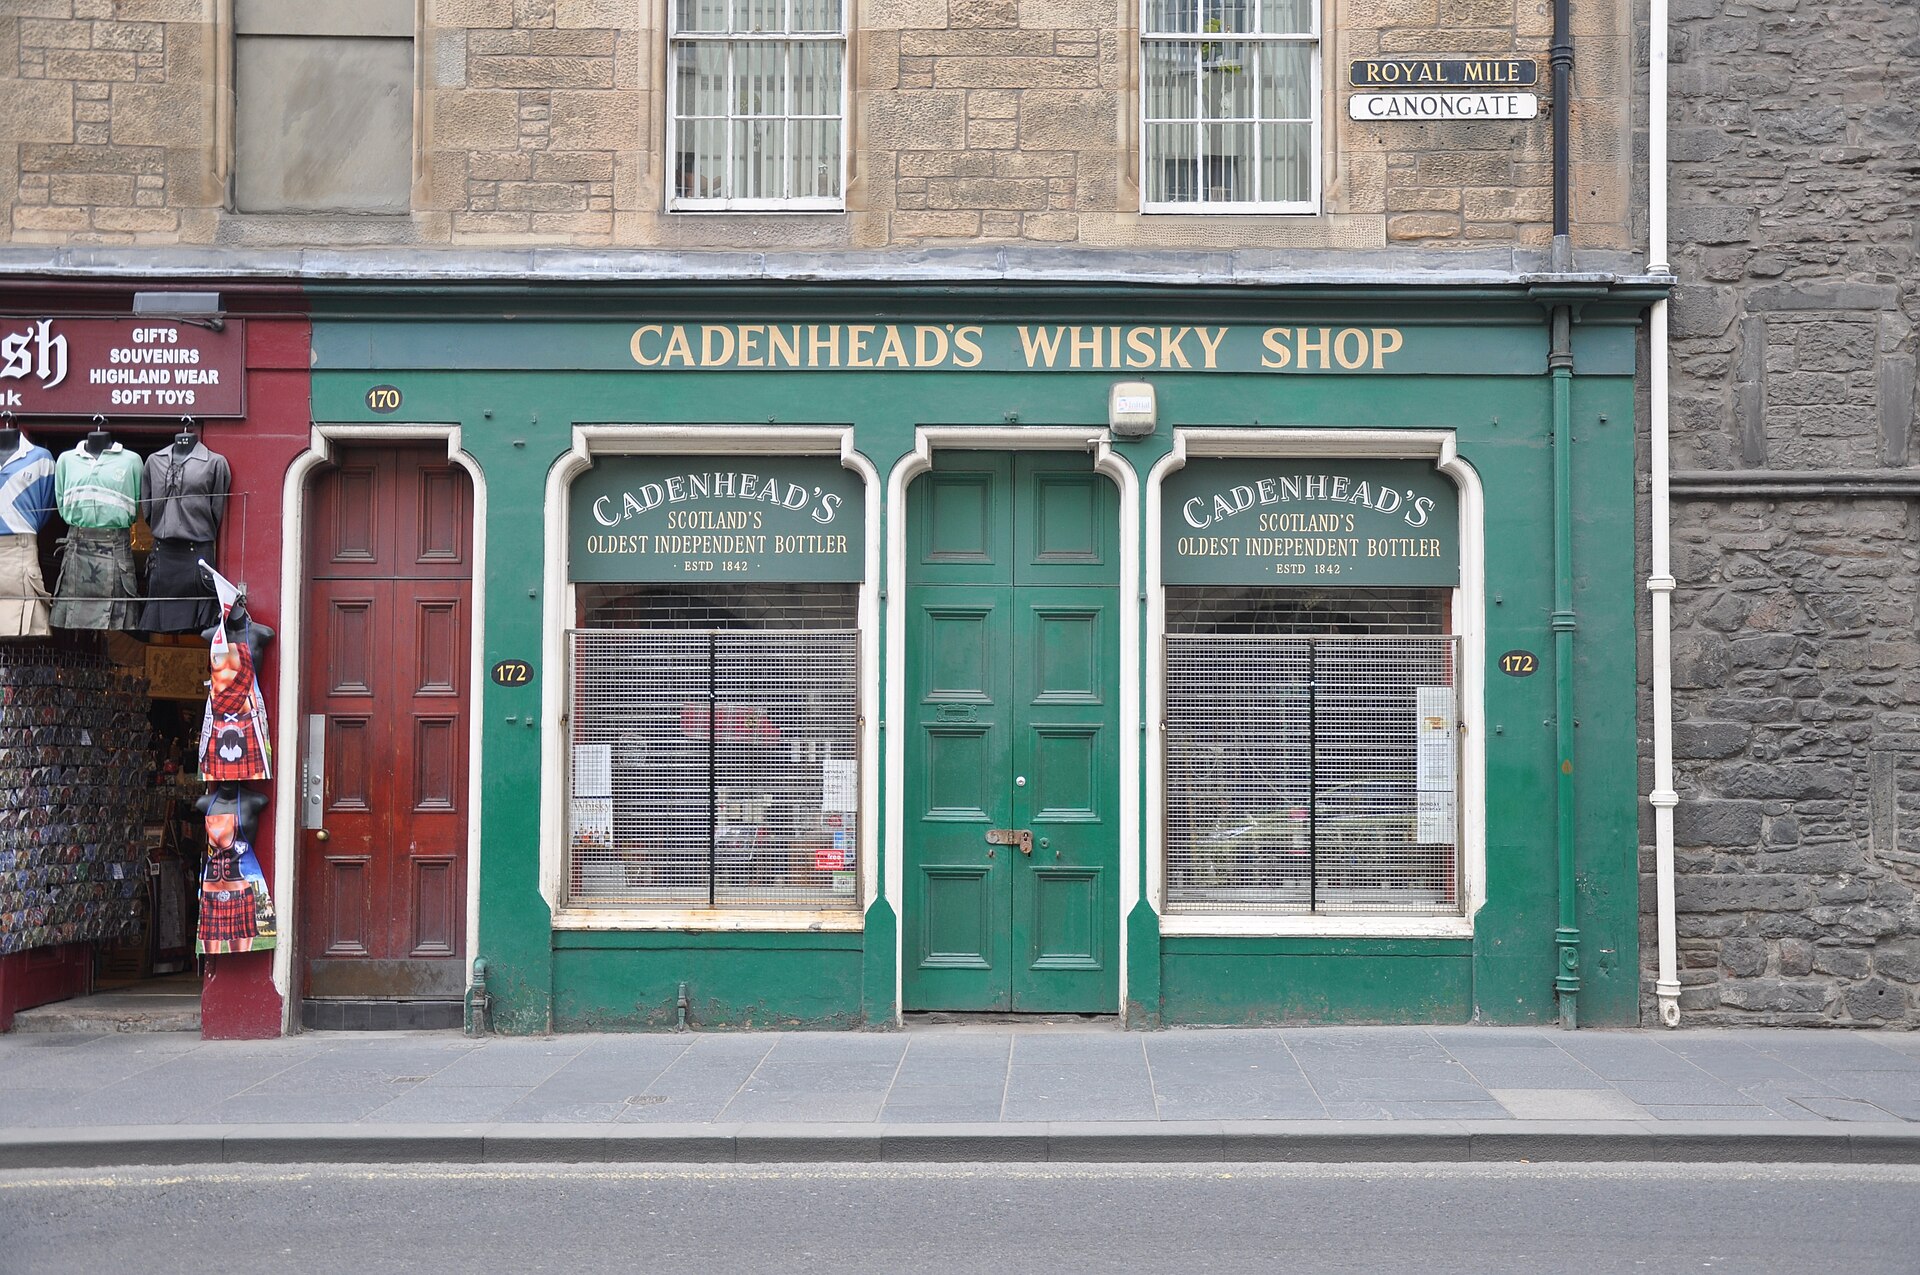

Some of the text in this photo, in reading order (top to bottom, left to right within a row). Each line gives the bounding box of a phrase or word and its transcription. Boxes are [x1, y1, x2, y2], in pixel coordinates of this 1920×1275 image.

[1366, 62, 1520, 82] ROYAL MILE
[1368, 95, 1519, 116] CANONGATE
[132, 328, 178, 343] GIFTS
[630, 323, 1404, 370] CADENHEAD'S WHISKY SHOP
[110, 349, 200, 364] SOUVENIRS
[90, 369, 219, 384] HIGHLAND WEAR
[111, 390, 195, 405] SOFT TOYS
[368, 390, 400, 408] 170
[592, 472, 843, 527] CADENHEAD'S
[1183, 475, 1435, 529] CADENHEAD'S
[668, 511, 762, 530] SCOTLAND'S
[1259, 513, 1355, 532] SCOTLAND'S
[587, 535, 847, 553] OLDEST INDEPENDENT BOTTLER
[1178, 537, 1441, 557] OLDEST INDEPENDENT BOTTLER
[684, 561, 748, 571] ESTD 1842
[1276, 563, 1341, 574] ESTD 1842
[1503, 655, 1533, 672] 172
[497, 665, 526, 681] 172
